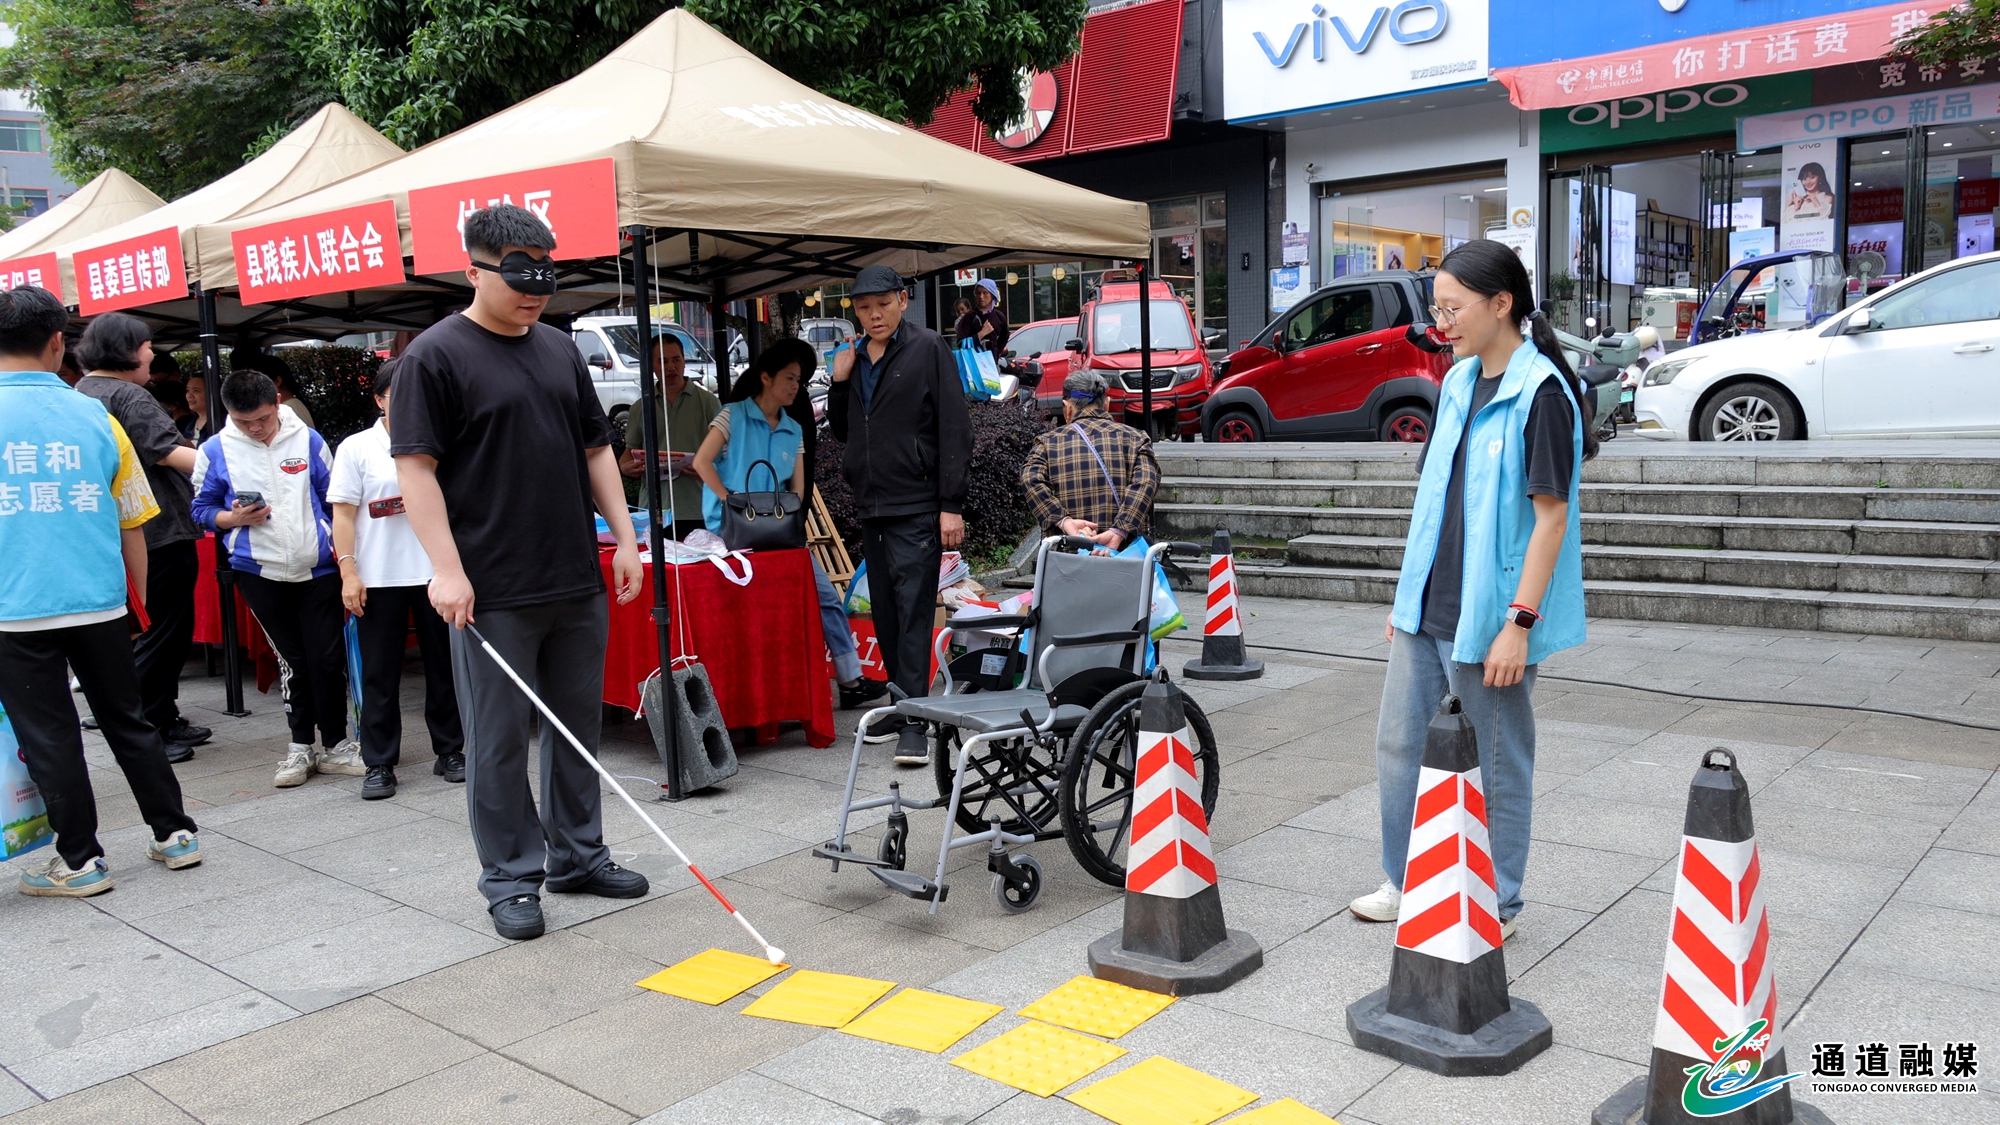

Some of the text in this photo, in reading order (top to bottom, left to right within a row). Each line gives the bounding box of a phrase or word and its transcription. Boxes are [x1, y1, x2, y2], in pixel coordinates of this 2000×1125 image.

[1252, 0, 1448, 67] vivo
[1672, 22, 1849, 79] 你打话费
[1585, 59, 1644, 84] 中国电信
[1585, 77, 1644, 91] CHINA TELECOM
[1803, 92, 1973, 134] OPPO 新品
[1798, 142, 1822, 150] vivo
[88, 245, 171, 300] 县委宣传部
[247, 221, 385, 288] 县残疾人联合会
[0, 480, 103, 516] 志愿者
